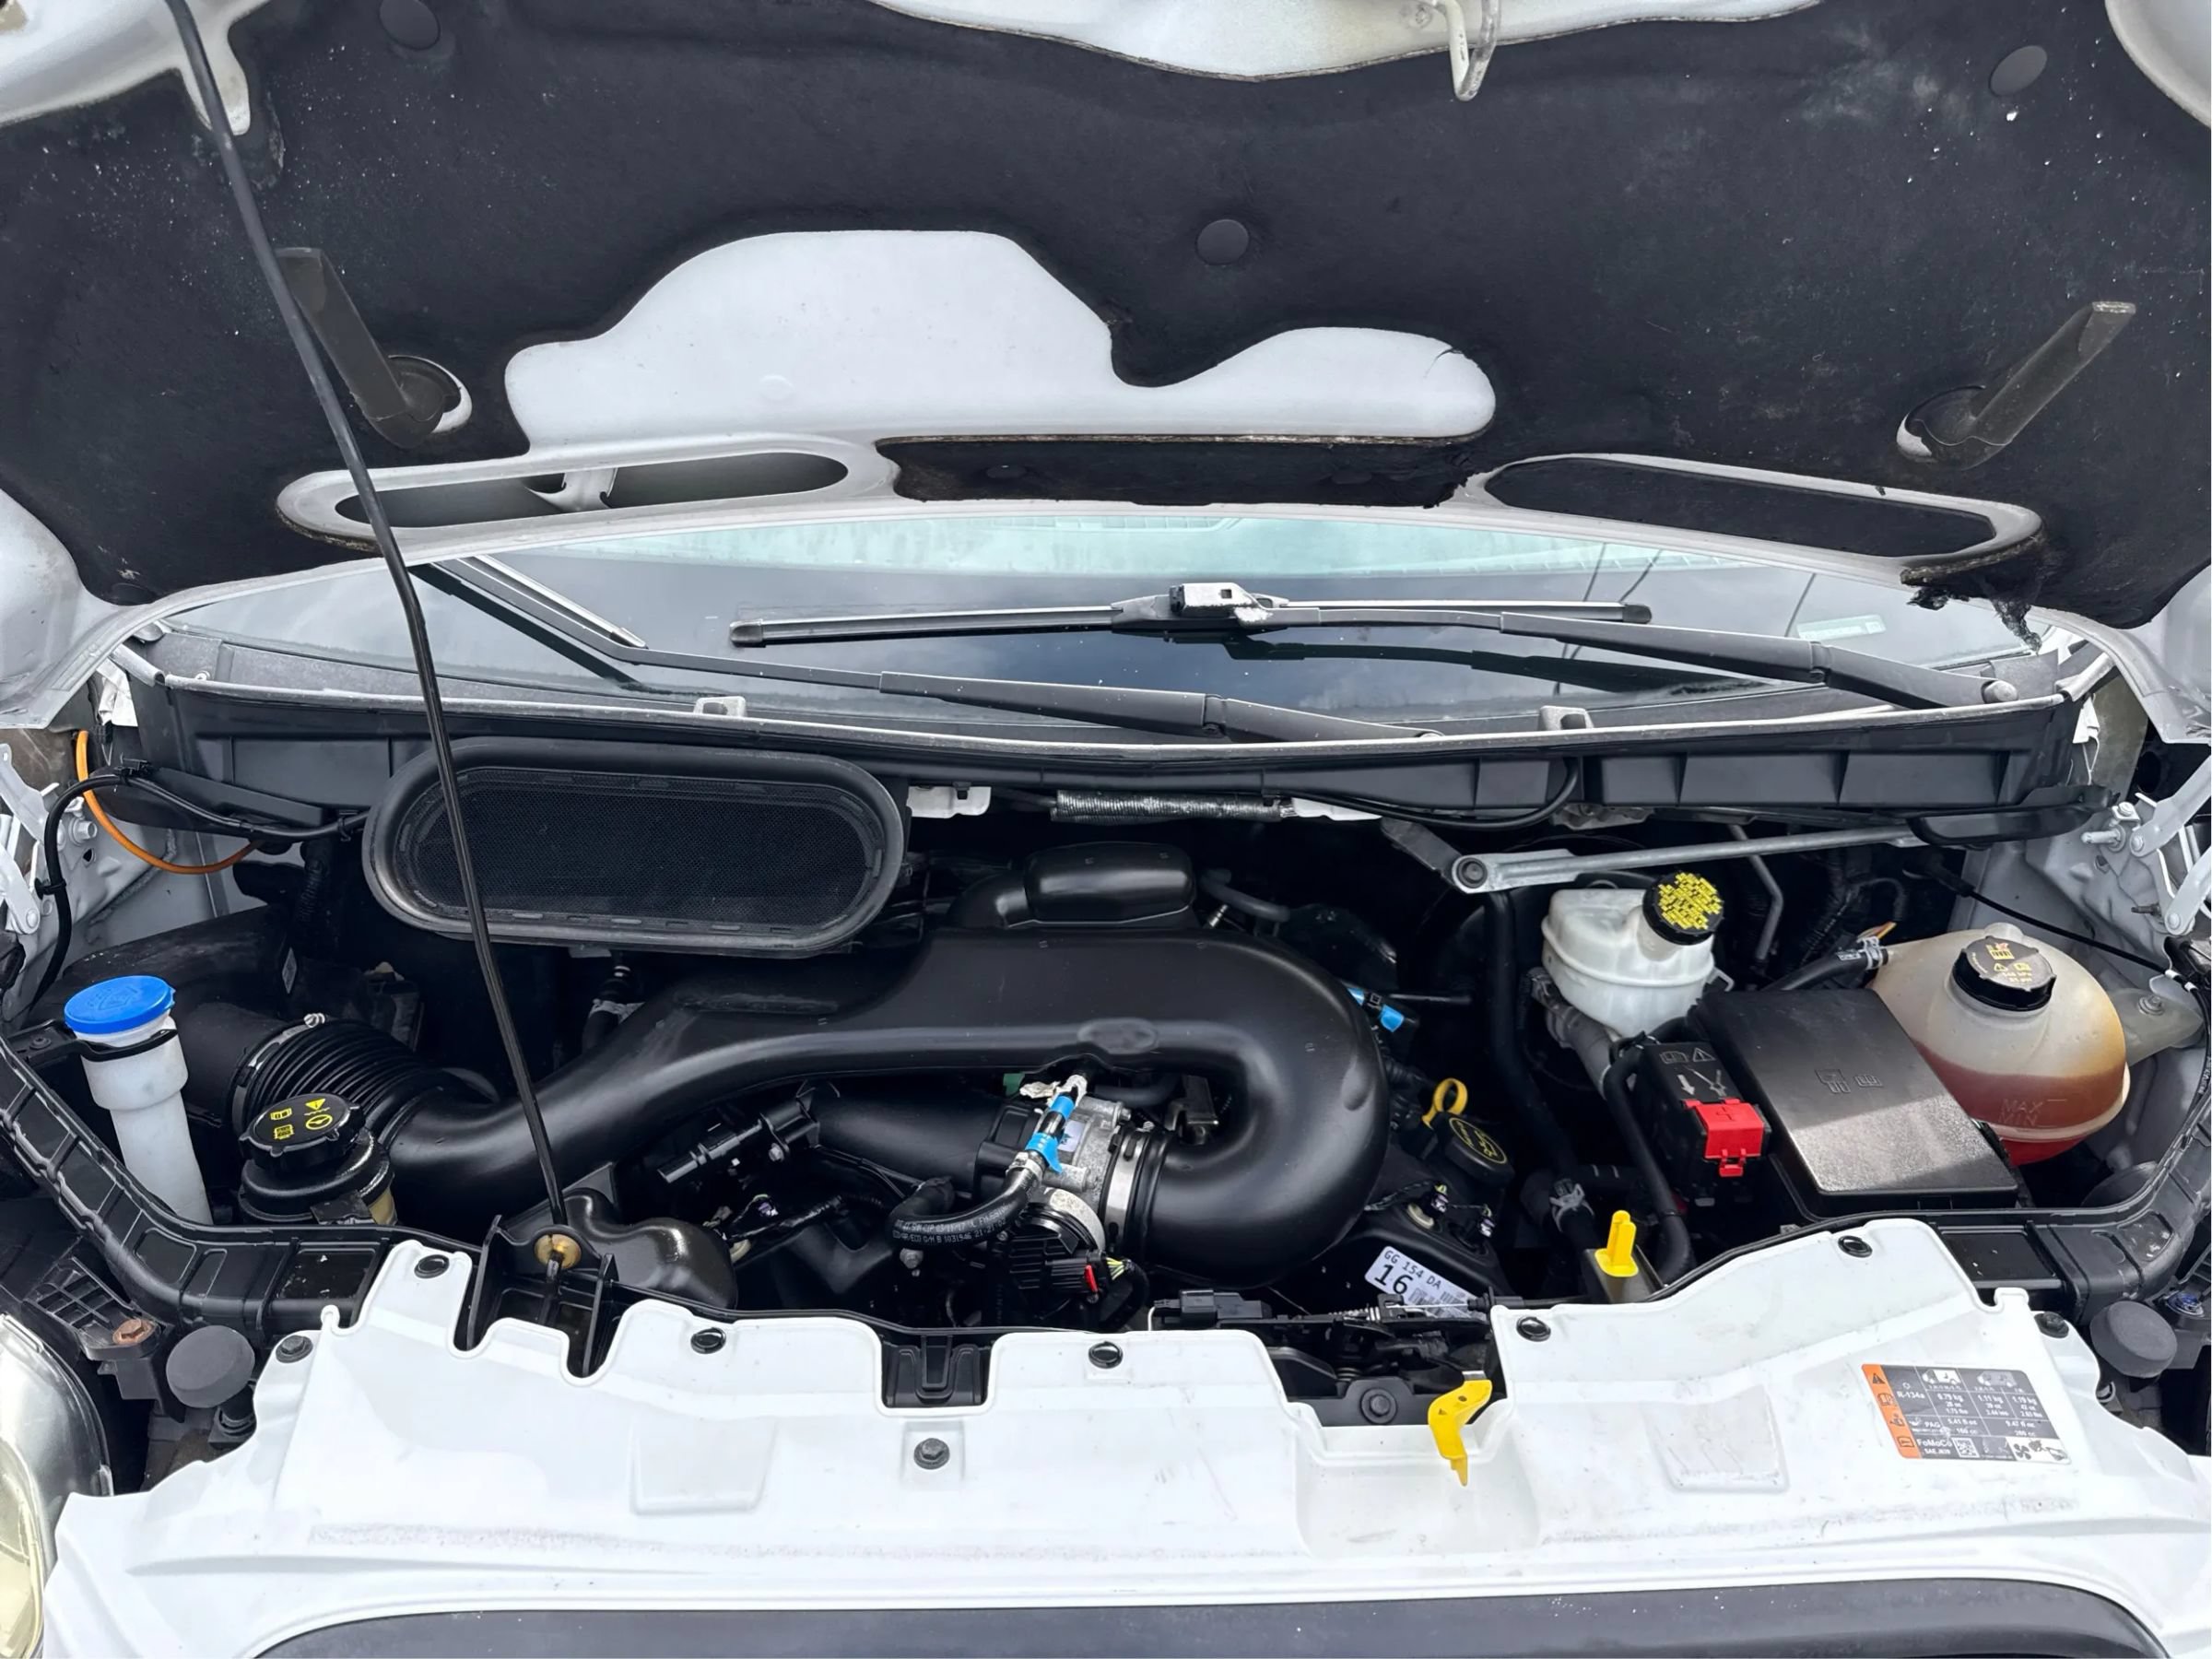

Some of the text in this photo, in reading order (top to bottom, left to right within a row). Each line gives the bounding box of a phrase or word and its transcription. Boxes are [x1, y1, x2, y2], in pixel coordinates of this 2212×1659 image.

[2002, 1099, 2043, 1114] MAX
[1998, 1112, 2039, 1126] MIN
[1383, 1250, 1441, 1289] GG 154 DA
[1374, 1264, 1414, 1294] 16
[1896, 1390, 1925, 1399] R-134a
[1916, 1438, 1952, 1447] FoMoCo
